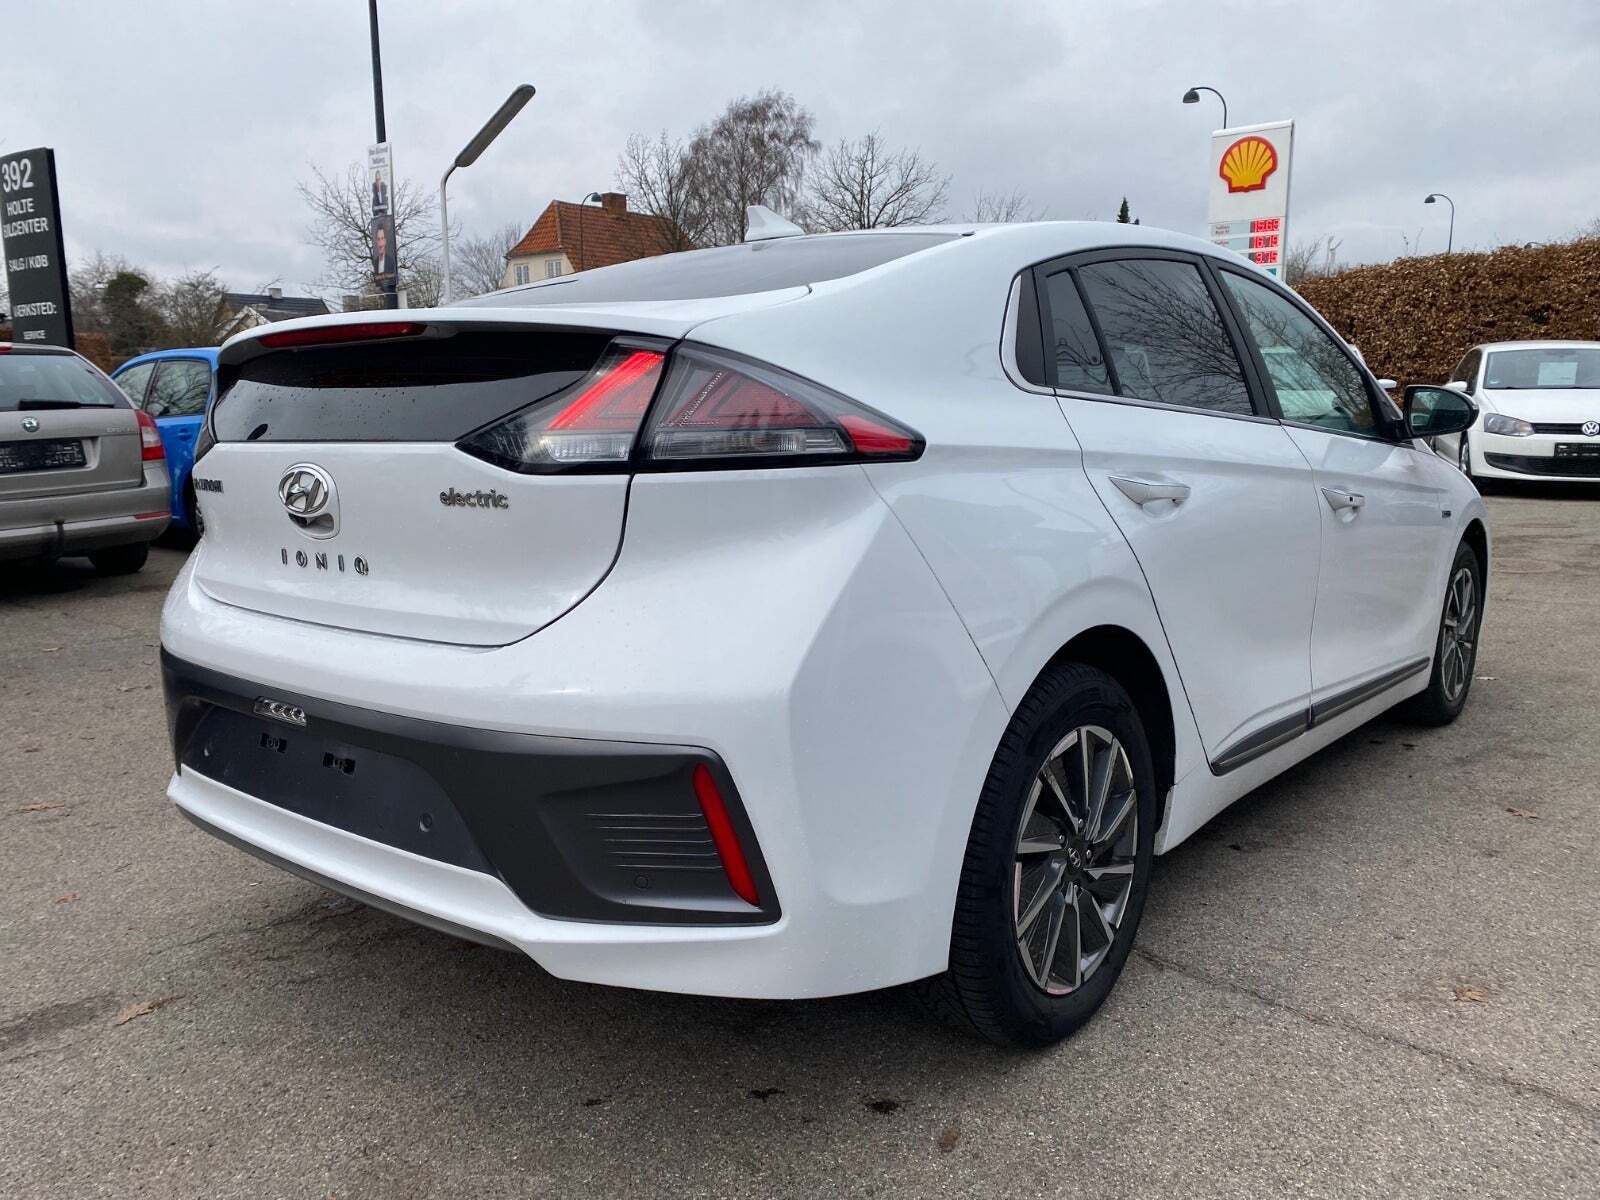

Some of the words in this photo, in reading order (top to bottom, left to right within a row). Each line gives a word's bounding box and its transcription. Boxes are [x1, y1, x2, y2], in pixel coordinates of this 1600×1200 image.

[1, 158, 34, 193] 392
[6, 198, 35, 216] HOLTE
[3, 217, 49, 238] BILCENTER
[439, 487, 509, 510] electric
[281, 548, 369, 576] IONIQ
